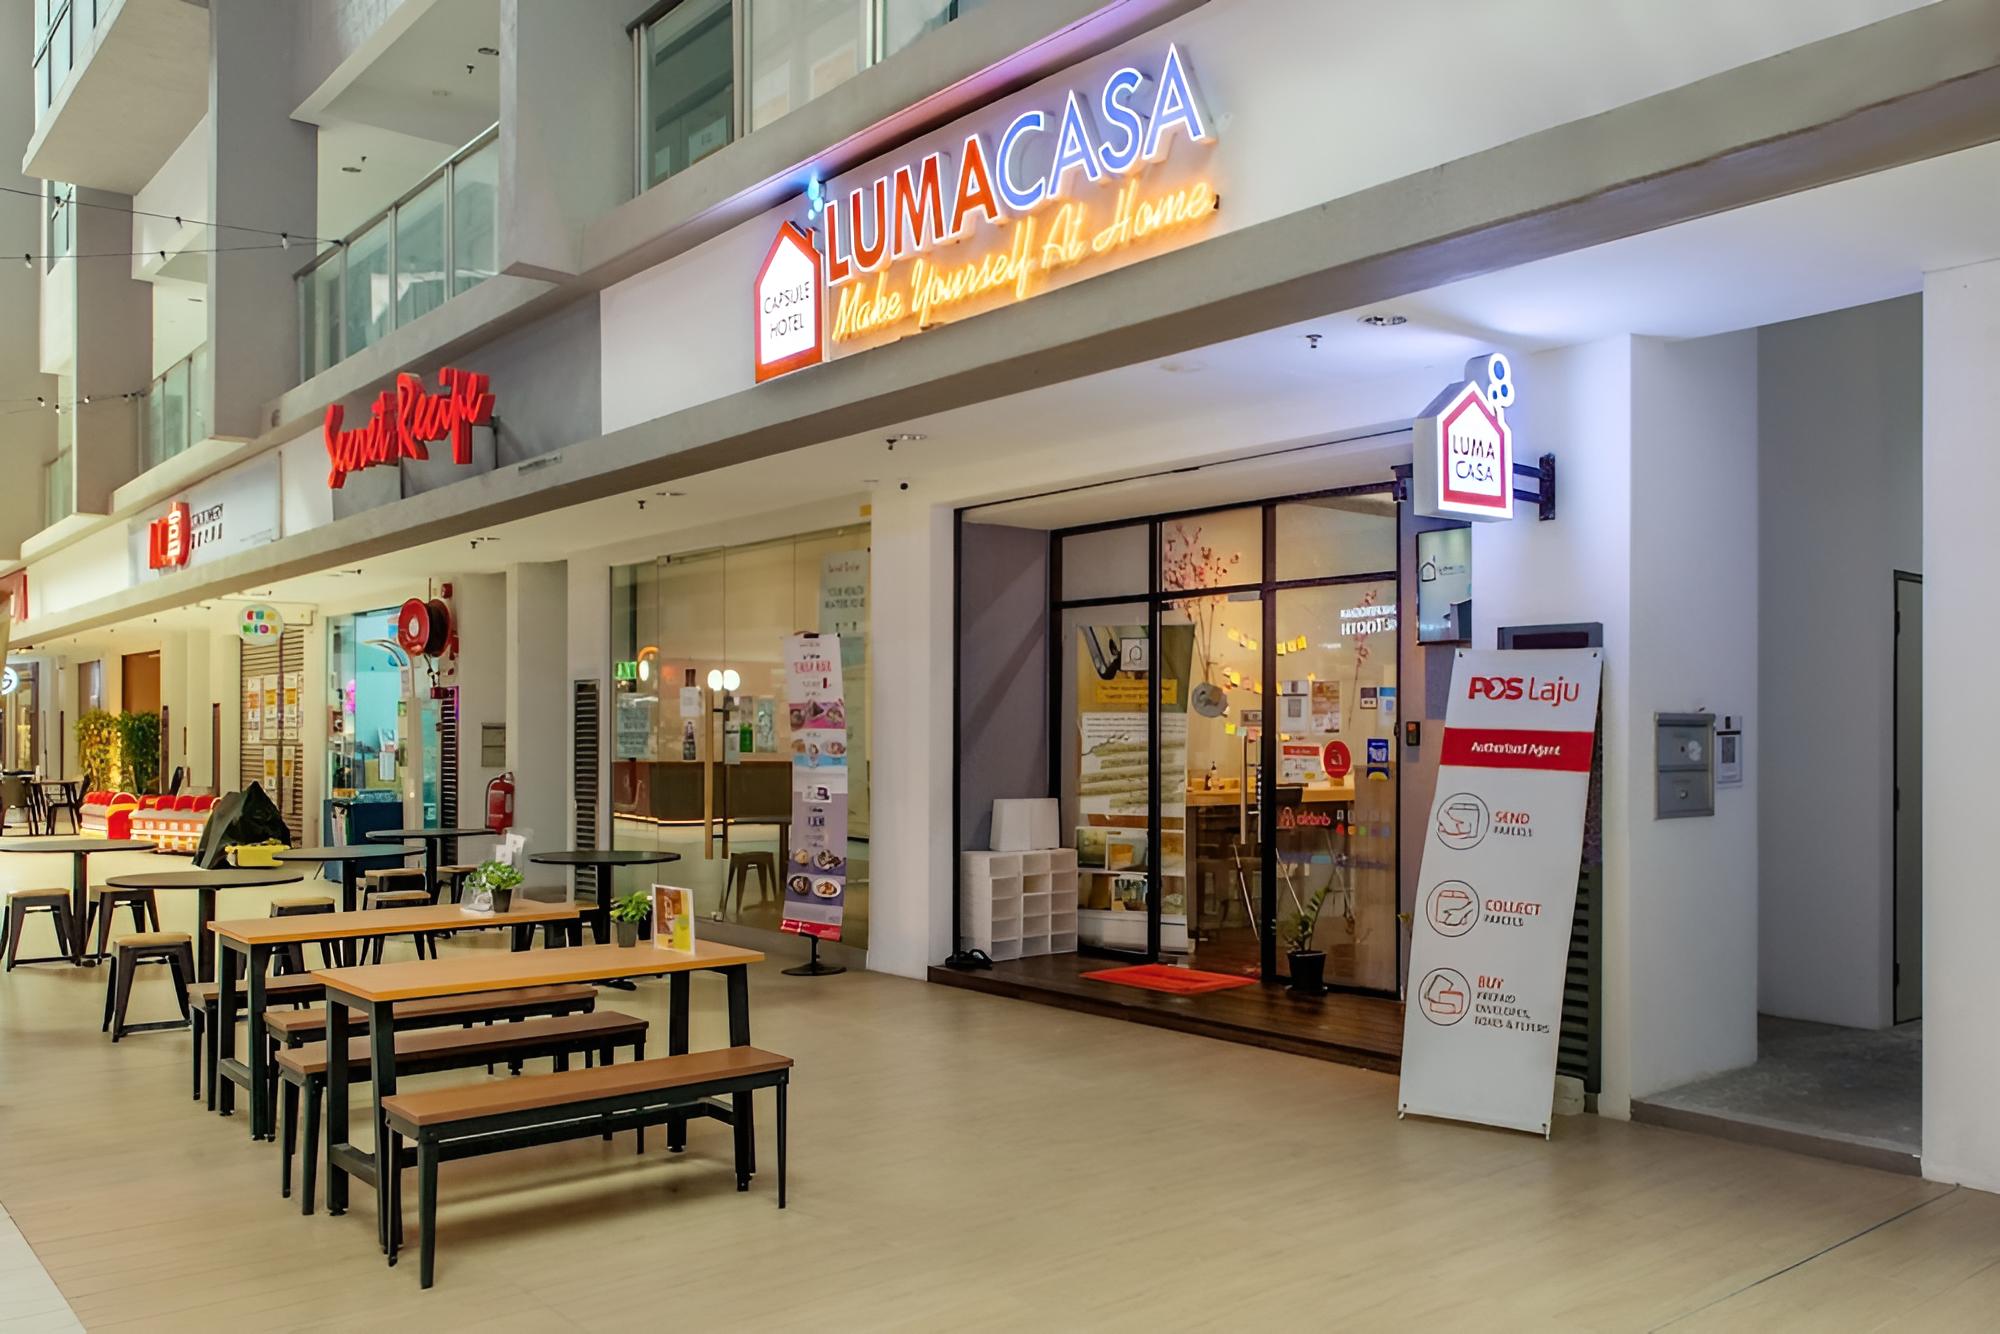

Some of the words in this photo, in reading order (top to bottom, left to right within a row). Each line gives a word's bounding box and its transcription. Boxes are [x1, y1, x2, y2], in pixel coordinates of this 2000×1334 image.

[831, 271, 903, 344] Make
[910, 216, 1036, 318] Yourself
[1040, 199, 1087, 271] At
[1092, 180, 1214, 252] Home
[763, 281, 810, 314] CAPSULE
[770, 312, 804, 340] HOTEL
[1452, 434, 1496, 460] LUMA
[1455, 460, 1495, 483] CASA
[1468, 676, 1523, 700] POS
[1528, 676, 1580, 707] Laju
[1528, 743, 1561, 758] Agent
[1495, 810, 1530, 825] SEND
[1485, 899, 1542, 916] COLLECT
[1478, 975, 1504, 989] BUY
